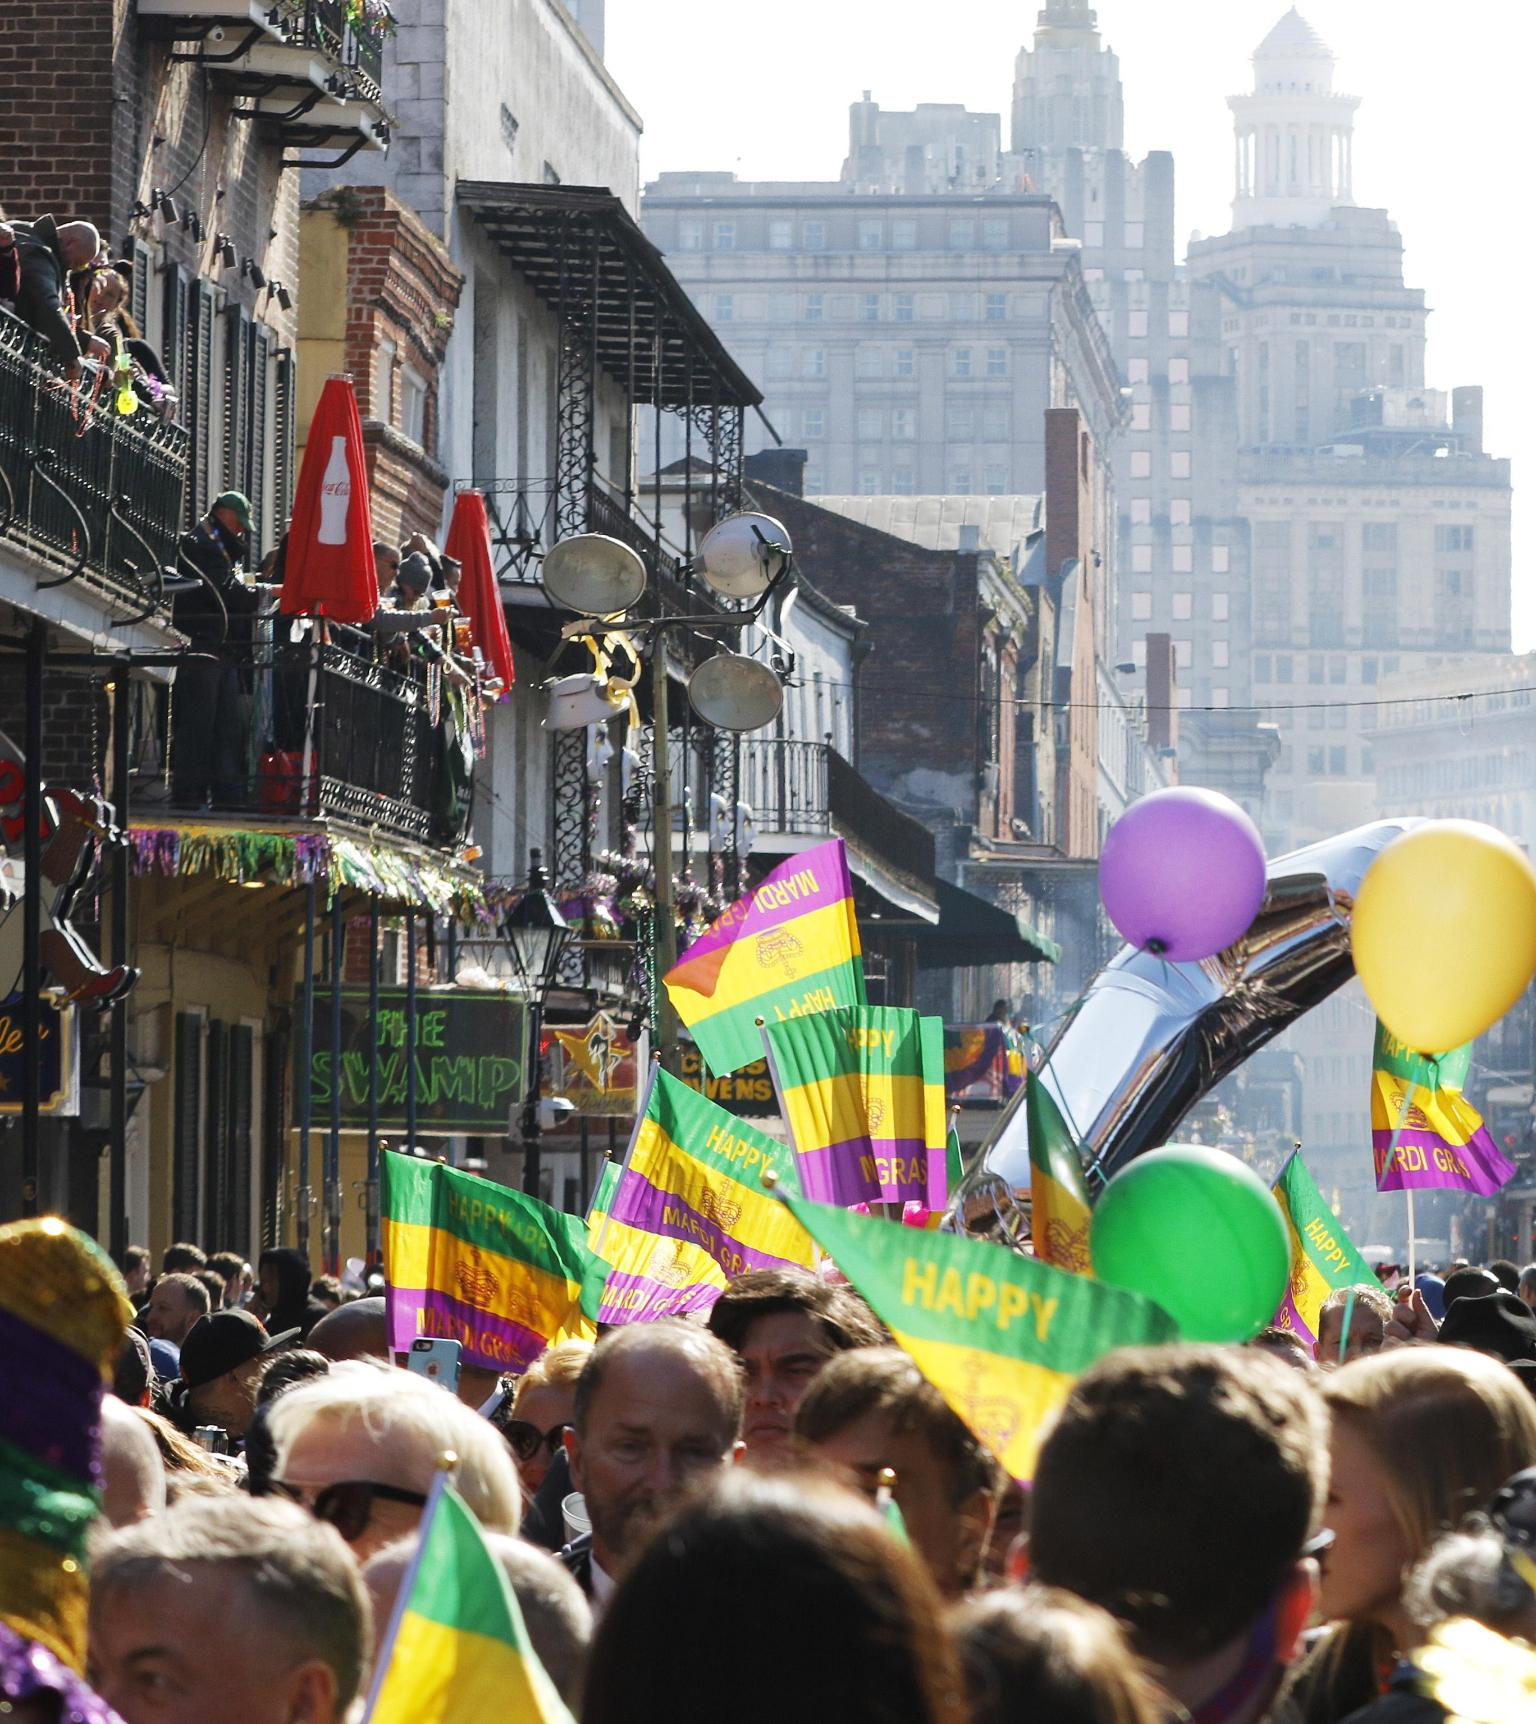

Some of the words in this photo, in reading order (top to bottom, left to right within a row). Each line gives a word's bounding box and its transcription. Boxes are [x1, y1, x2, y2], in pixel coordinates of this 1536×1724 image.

[753, 869, 821, 914] MARDI
[366, 1009, 447, 1047] THE
[310, 1051, 521, 1110] SWAMP
[706, 1125, 775, 1177] HAPPY
[449, 1192, 513, 1233] HAPPY
[663, 1205, 716, 1256] MARDI
[1304, 1217, 1351, 1274] HAPPY
[602, 1284, 651, 1314] MARDI
[902, 1257, 1059, 1344] HAPPY
[416, 1307, 476, 1351] MARDI
